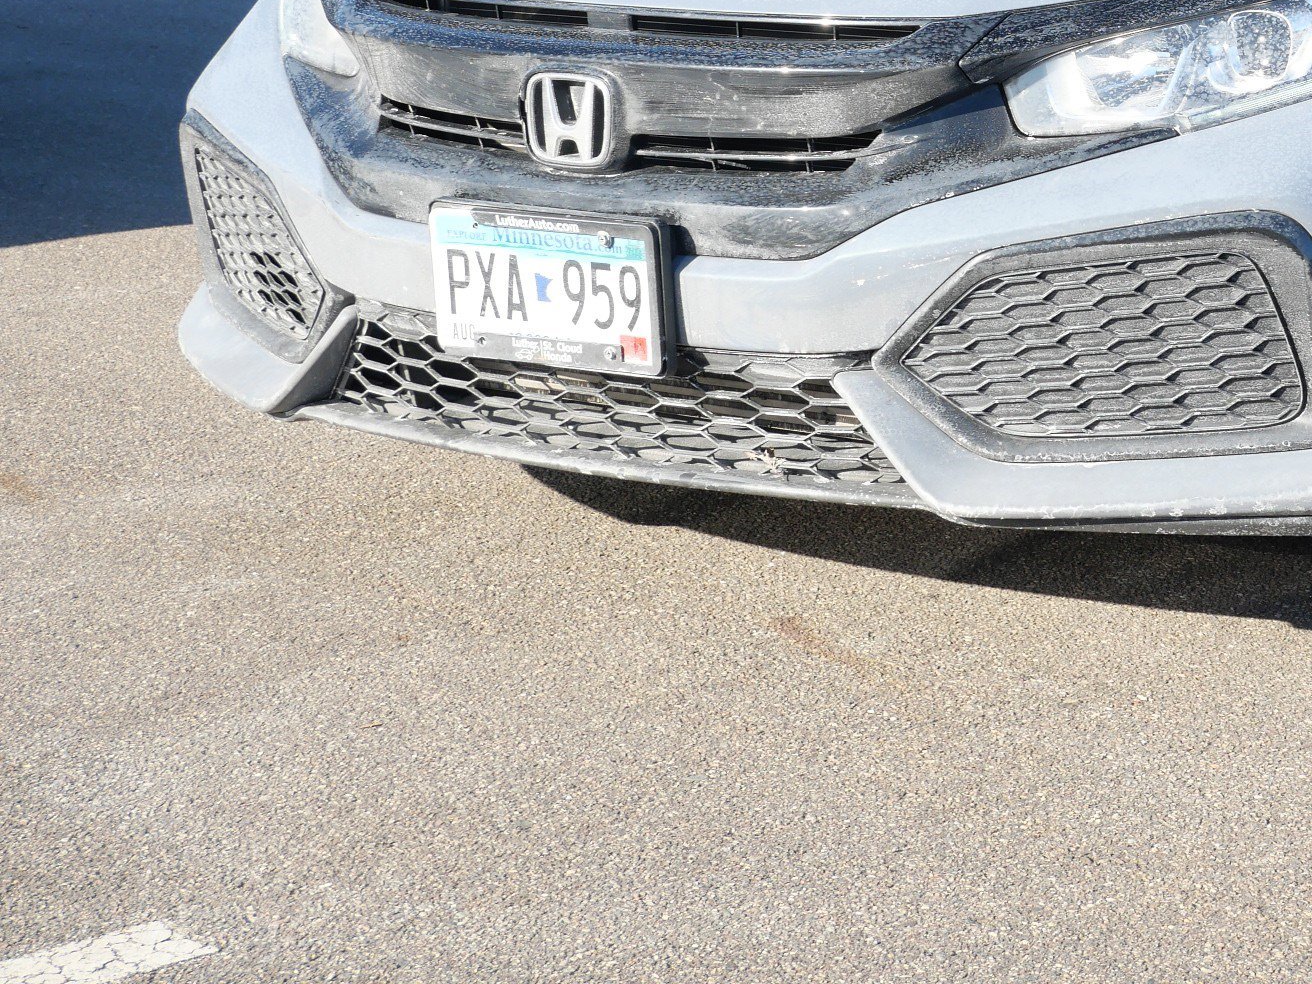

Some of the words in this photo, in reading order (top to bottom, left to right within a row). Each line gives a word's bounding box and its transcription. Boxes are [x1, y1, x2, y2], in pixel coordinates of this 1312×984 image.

[495, 214, 579, 233] LutherAuto.com
[446, 248, 528, 321] PXA
[562, 259, 642, 332] 959
[511, 336, 540, 350] Luther
[542, 340, 555, 351] St.
[556, 342, 583, 354] Cloud
[543, 350, 573, 363] Honda
